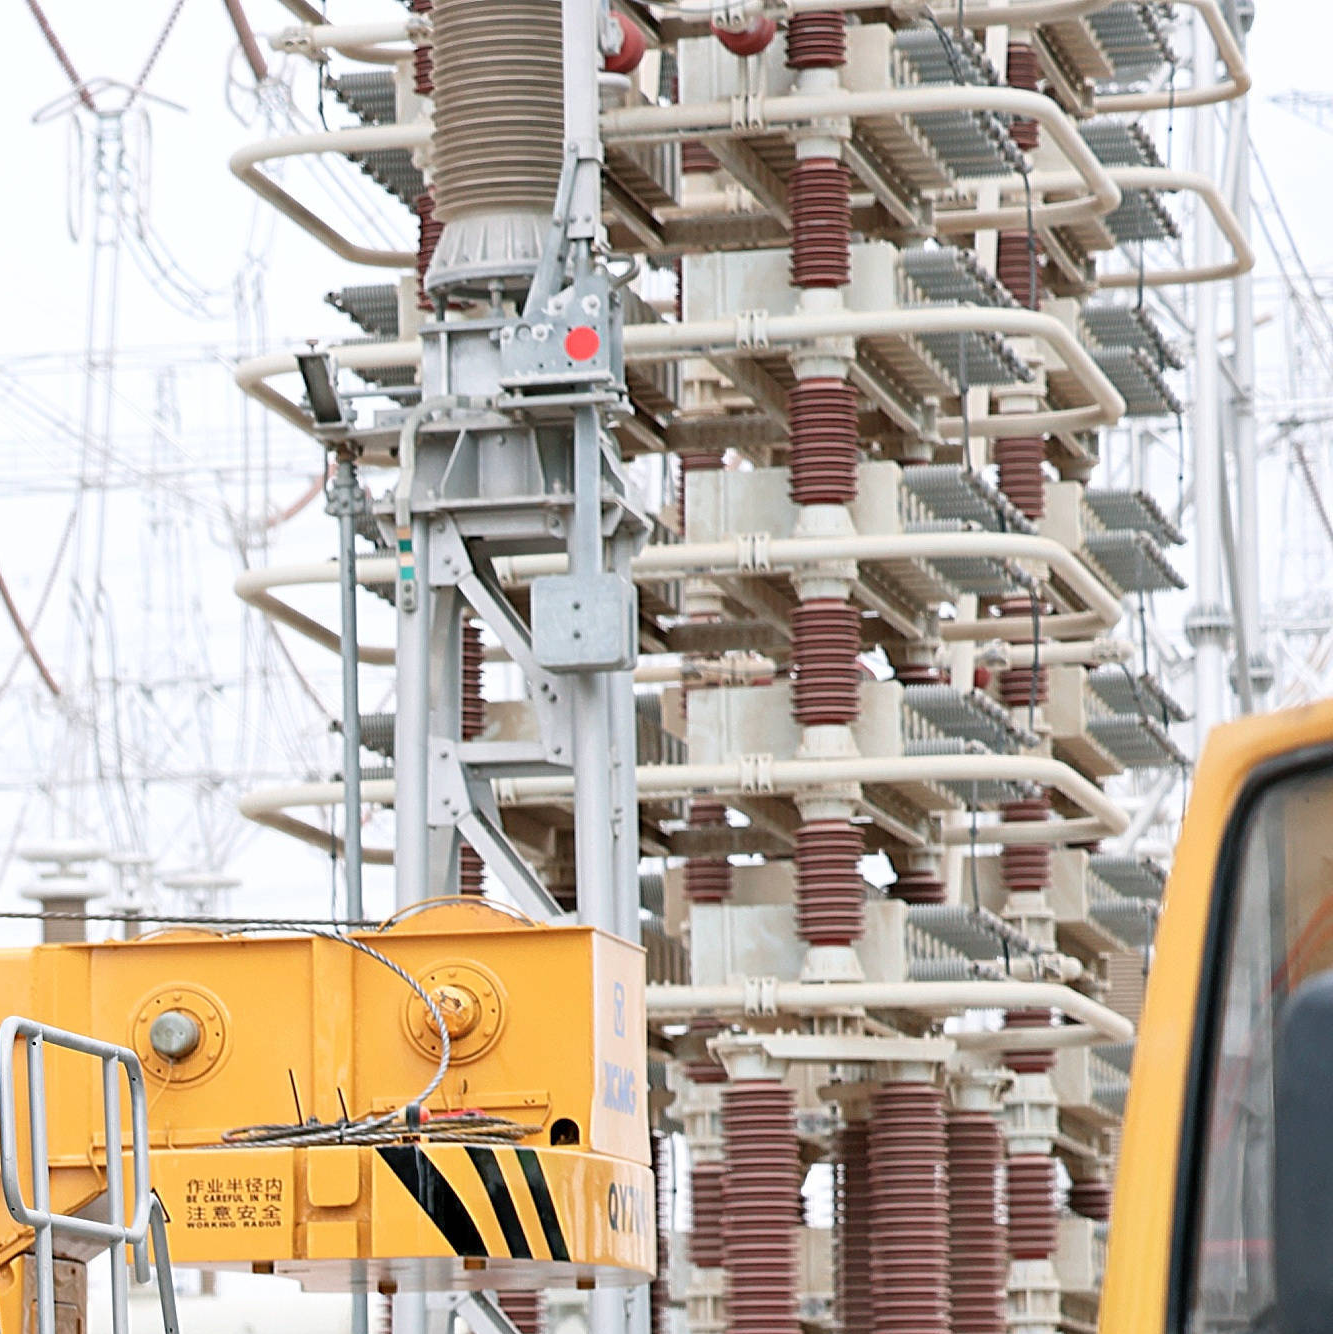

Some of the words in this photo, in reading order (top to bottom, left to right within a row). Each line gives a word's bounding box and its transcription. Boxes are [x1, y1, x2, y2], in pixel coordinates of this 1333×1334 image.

[186, 1177, 282, 1193] 作业半径内
[186, 1194, 197, 1202] BE
[203, 1194, 244, 1202] CAREFUL
[250, 1194, 259, 1202] IN
[265, 1193, 282, 1202] THE
[186, 1204, 282, 1220] 注意安全
[186, 1221, 237, 1229] WORKING
[243, 1220, 282, 1228] RADIUS
